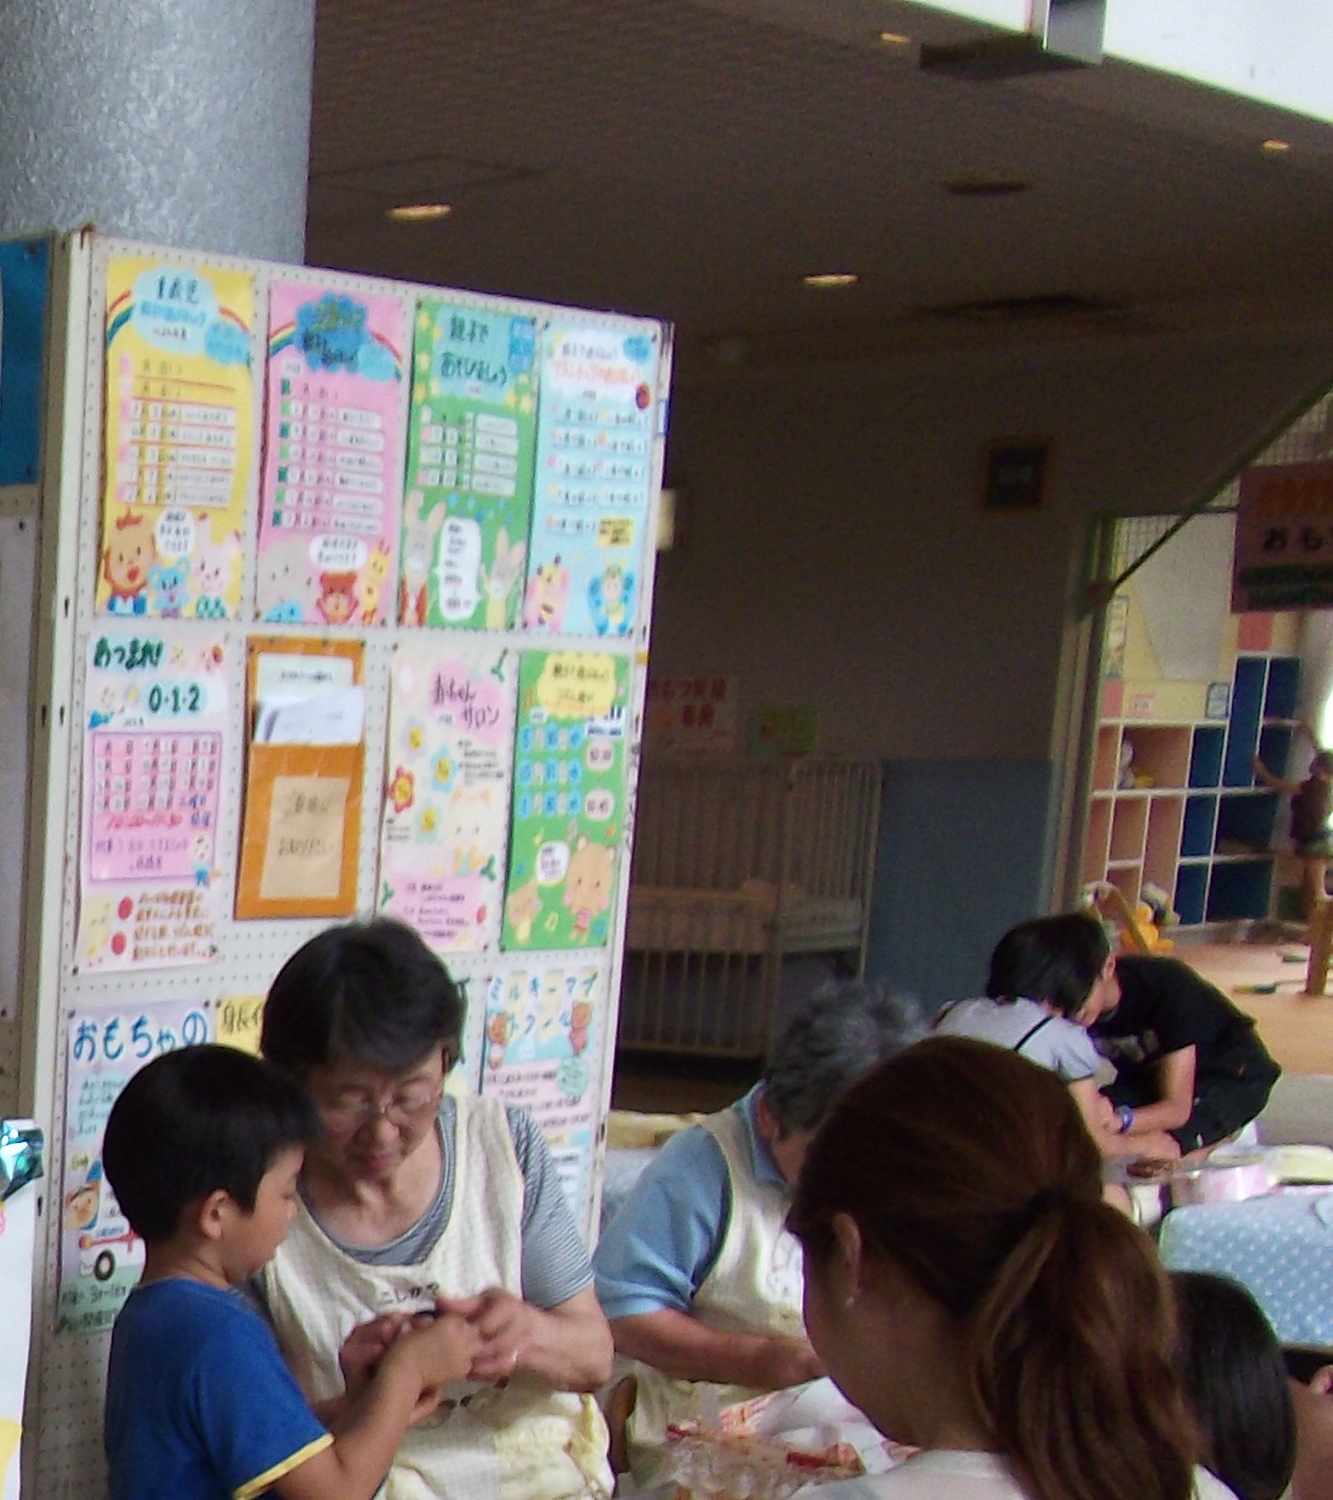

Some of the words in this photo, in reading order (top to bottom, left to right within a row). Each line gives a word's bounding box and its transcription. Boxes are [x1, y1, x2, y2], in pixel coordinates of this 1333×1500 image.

[73, 1009, 208, 1062] おもちゃの
